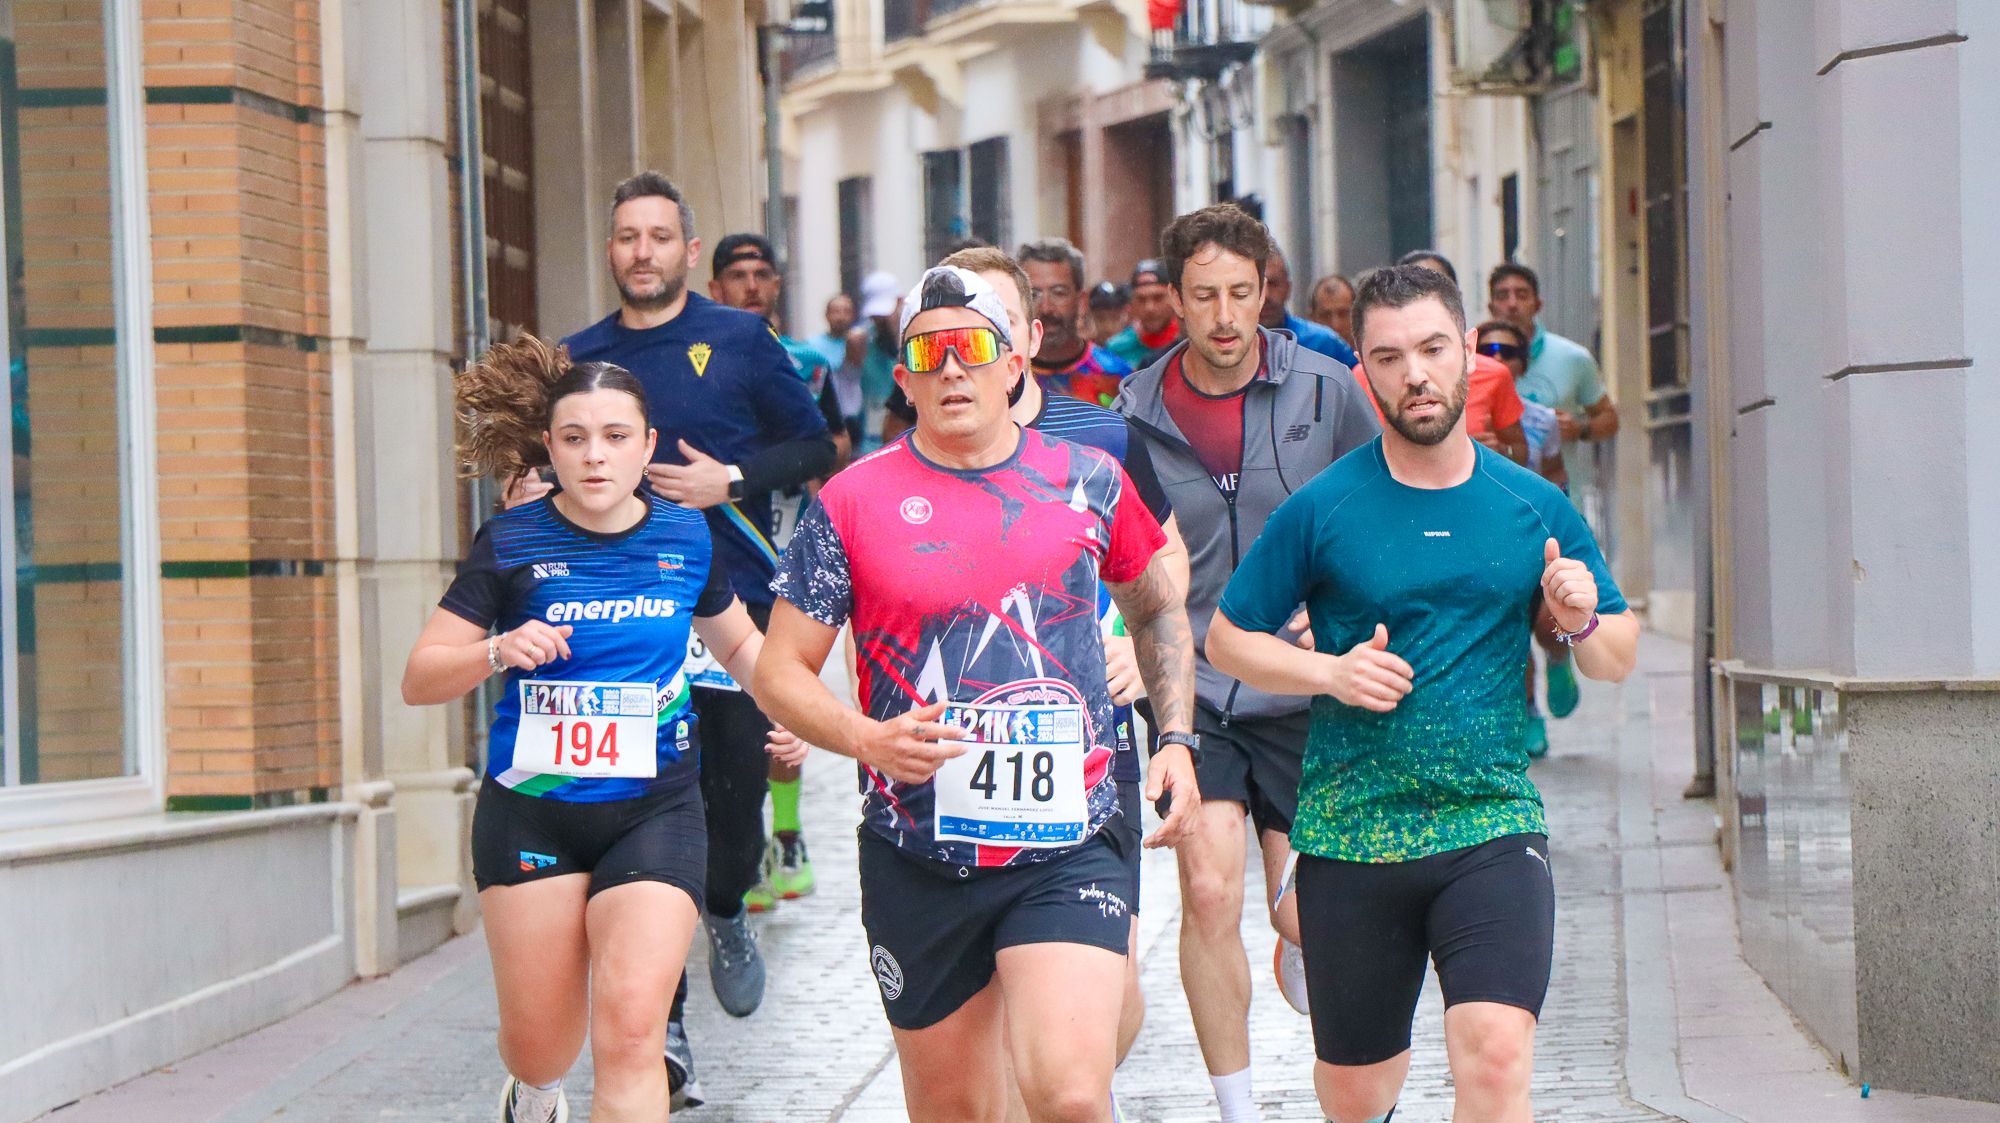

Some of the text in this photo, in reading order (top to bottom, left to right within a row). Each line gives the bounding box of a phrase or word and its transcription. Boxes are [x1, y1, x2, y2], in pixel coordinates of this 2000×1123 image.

[548, 562, 567, 570] RUN
[551, 569, 570, 577] PRO
[546, 595, 675, 623] enerplus
[538, 686, 578, 715] 21K
[962, 709, 1010, 743] 21K
[551, 721, 620, 766] 194
[970, 750, 1054, 802] 418
